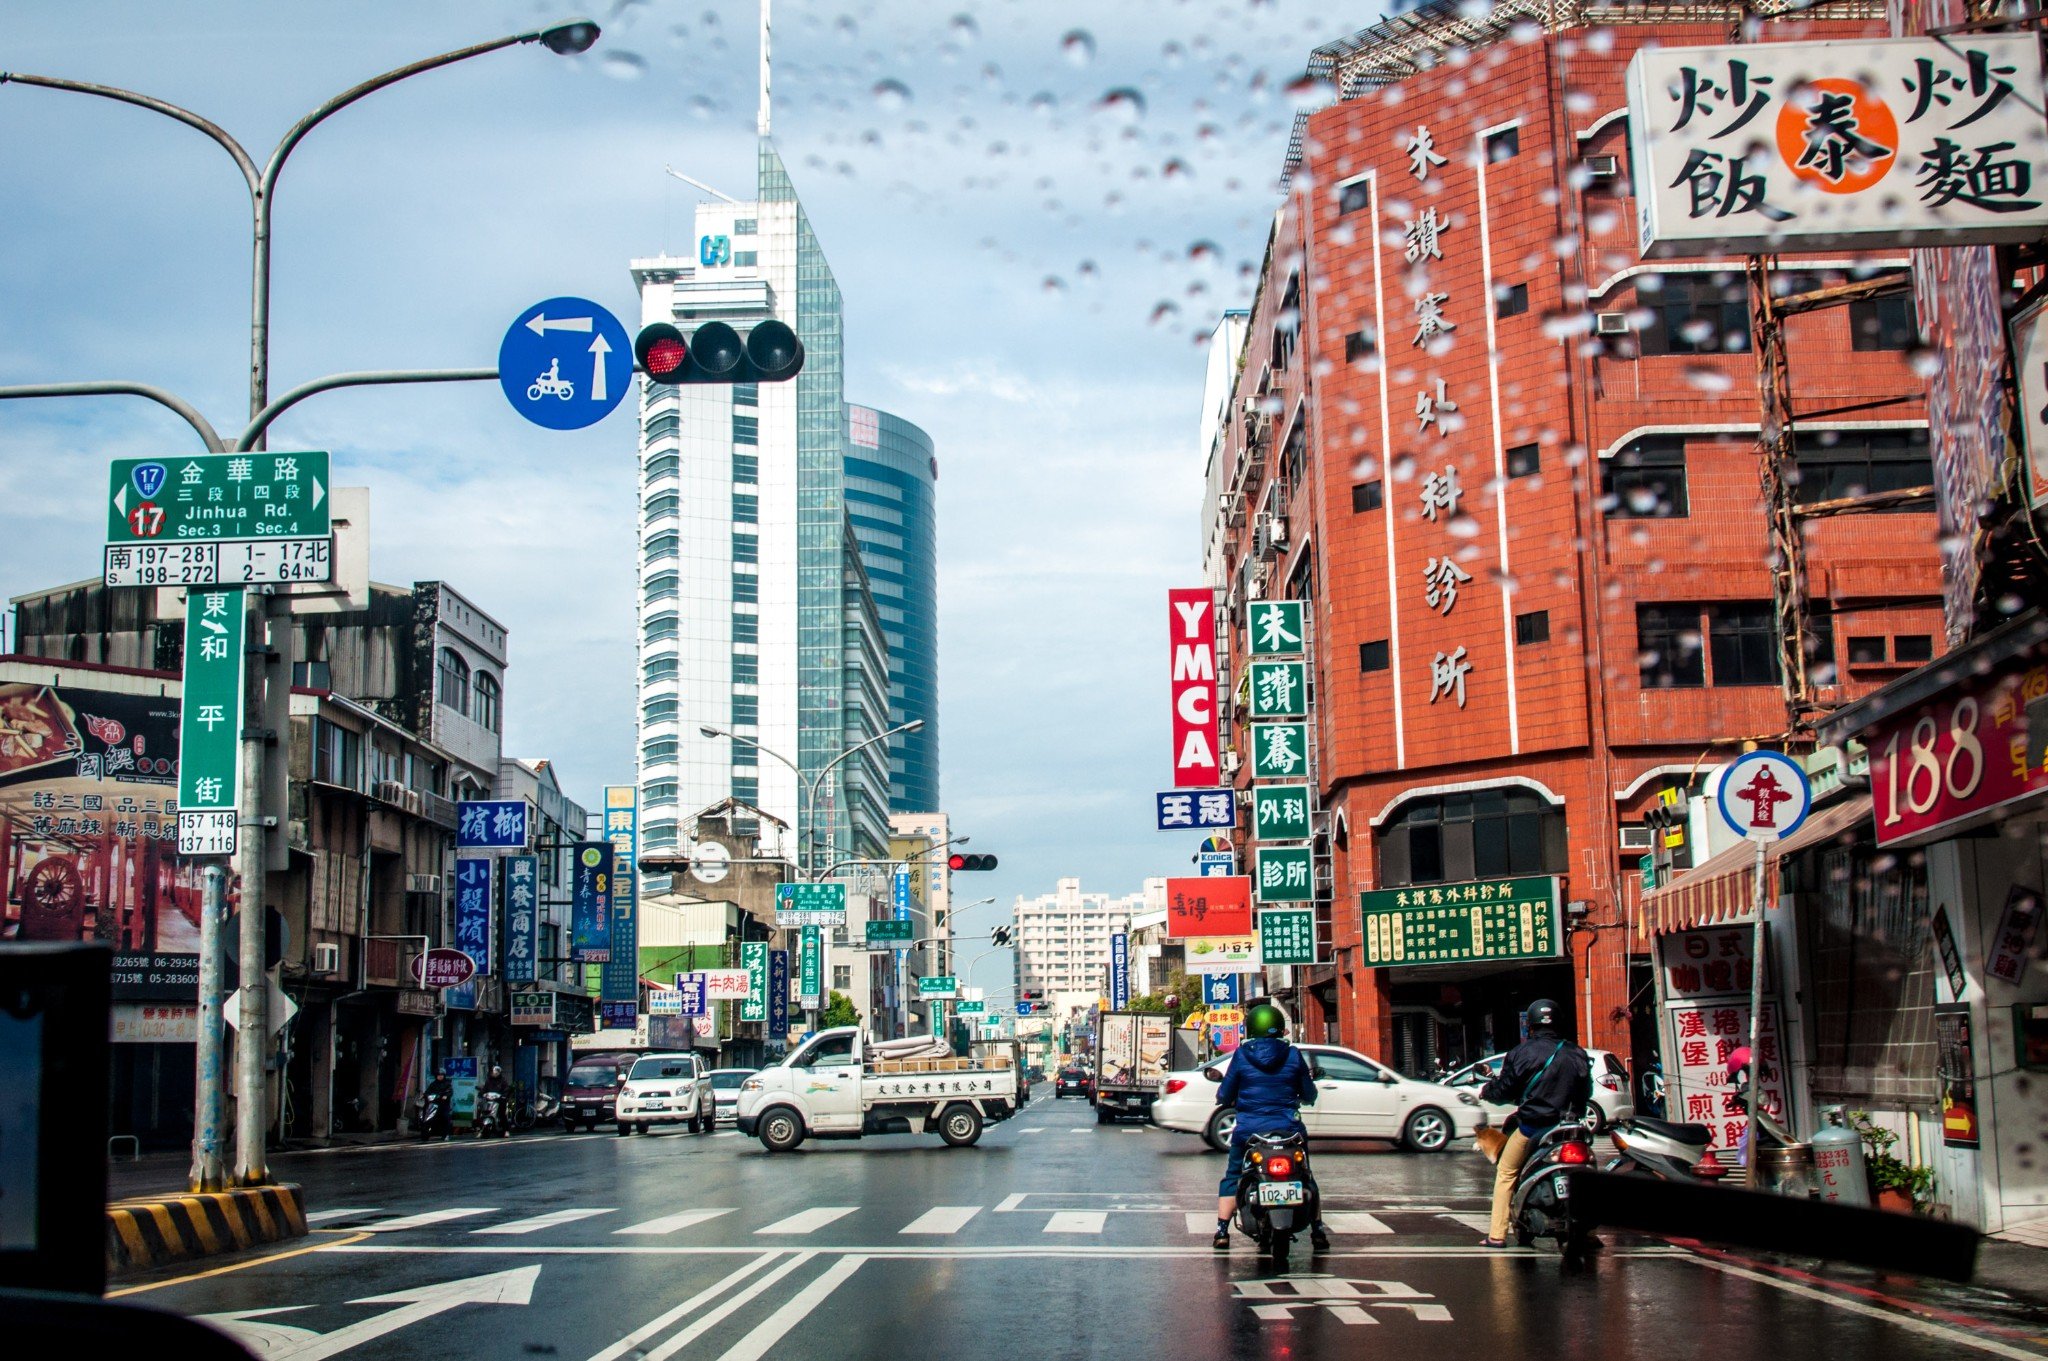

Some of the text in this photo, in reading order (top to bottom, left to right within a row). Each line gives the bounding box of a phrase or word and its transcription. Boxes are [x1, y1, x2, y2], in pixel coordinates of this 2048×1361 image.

[1668, 59, 1797, 222] 炒飯
[1798, 91, 1892, 184] 泰
[140, 469, 158, 482] 17
[180, 458, 300, 485] 金華路
[177, 484, 300, 502] 三段 四段
[134, 508, 164, 535] 17
[185, 504, 292, 520] Jinhua Rd.
[177, 522, 298, 537] Sec.3 Sec.4
[109, 546, 214, 569] 南 197-281
[305, 542, 328, 563] 北
[108, 566, 213, 584] S. 198-272
[202, 591, 229, 617] 東
[1173, 602, 1215, 768] YMCA
[195, 635, 228, 803] 和平街
[1884, 697, 1983, 827] 188
[33, 792, 103, 811] 話三國
[1162, 794, 1230, 826] 王冠
[1259, 798, 1305, 825] 外科
[33, 815, 104, 835] 舊麻辣
[180, 815, 233, 829] 157 148
[460, 806, 523, 843] 檳榔
[180, 837, 233, 851] 137 116
[1202, 853, 1231, 861] Konica
[1263, 860, 1307, 888] 診所
[508, 860, 534, 958] 興發商店
[1535, 901, 1548, 952] 門診項目
[1218, 942, 1254, 953] 小豆子
[154, 958, 200, 968] 06-29345
[709, 975, 748, 994] 牛肉湯
[772, 952, 785, 1031] 大新洗衣中心
[1678, 1011, 1709, 1066] 漢堡
